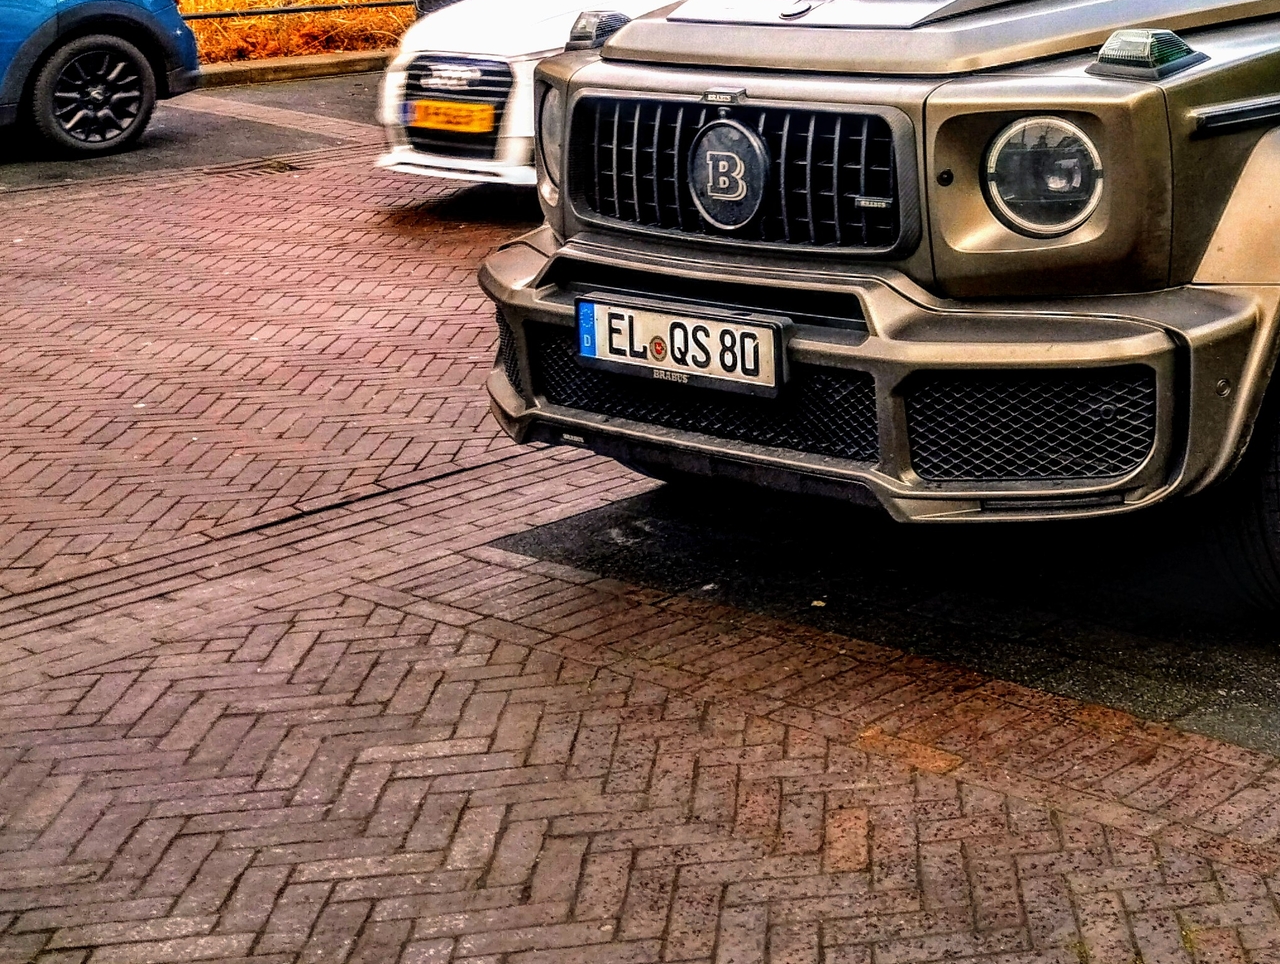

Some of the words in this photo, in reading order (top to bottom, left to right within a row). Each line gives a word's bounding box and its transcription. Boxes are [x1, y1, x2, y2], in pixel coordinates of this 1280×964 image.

[706, 150, 747, 201] B
[584, 334, 591, 347] D
[607, 311, 648, 361] EL
[668, 321, 711, 369] QS
[719, 328, 760, 377] 80
[652, 369, 689, 384] BRABUS
